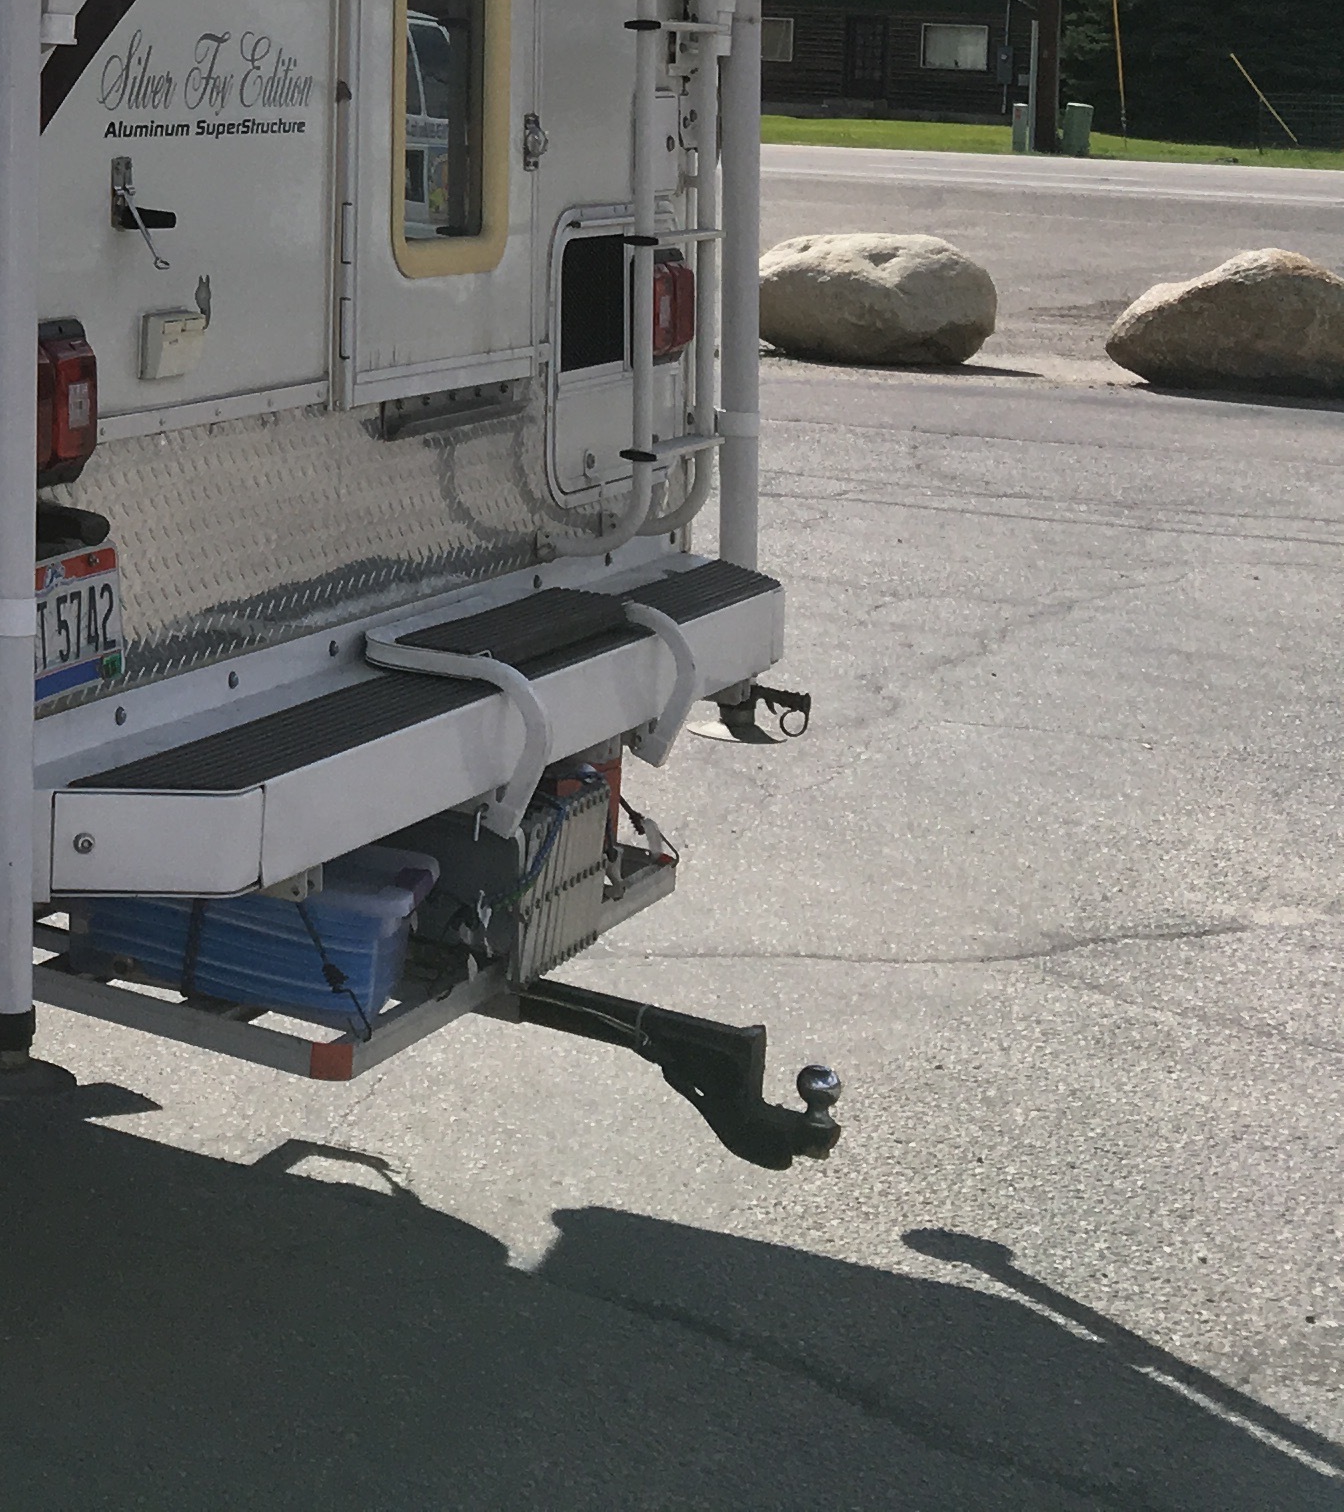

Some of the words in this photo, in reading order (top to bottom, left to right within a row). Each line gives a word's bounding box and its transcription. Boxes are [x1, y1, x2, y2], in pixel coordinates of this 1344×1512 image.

[97, 29, 176, 111] Silver
[184, 31, 234, 116] Fox
[239, 31, 314, 109] Edition
[104, 120, 191, 139] Aluminum
[195, 117, 306, 139] SuperStructure
[56, 582, 116, 663] 5742
